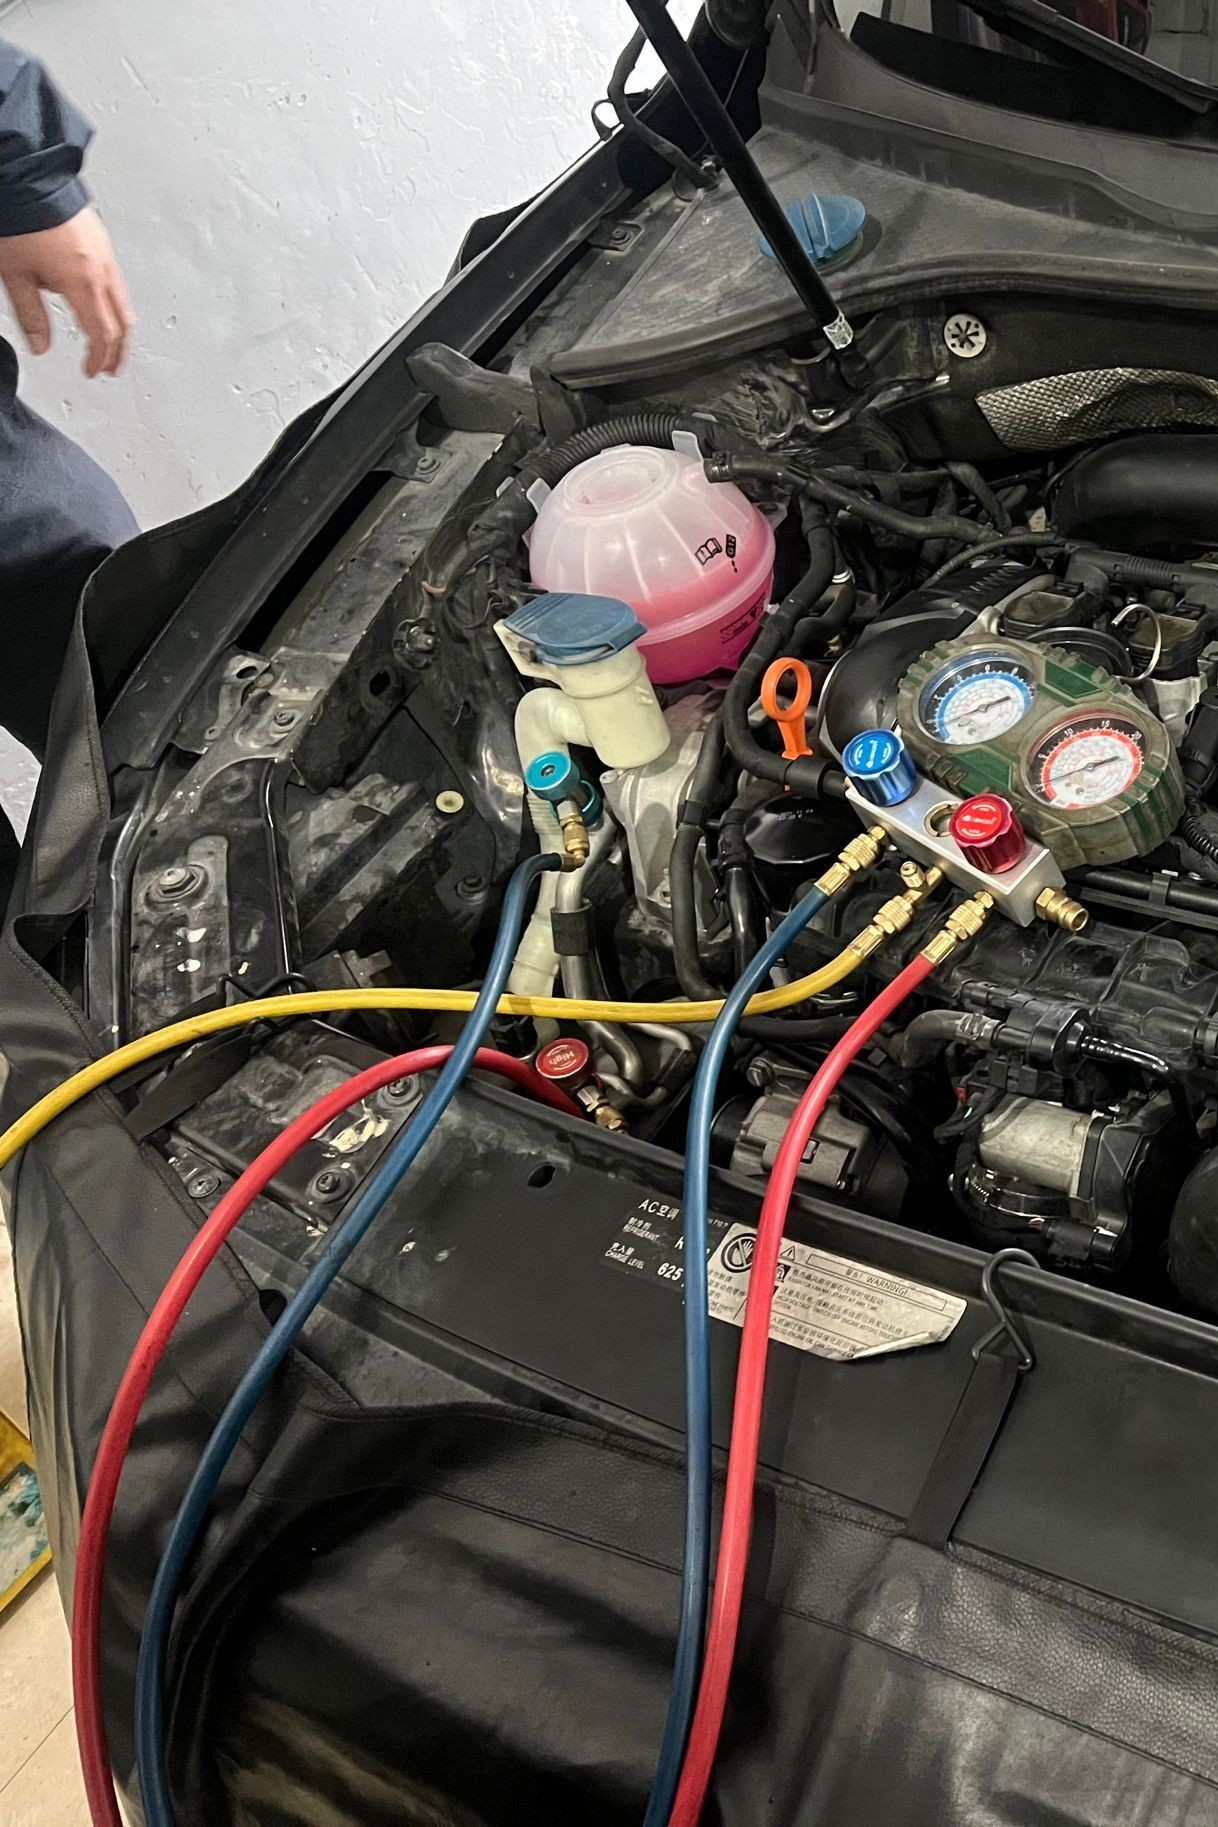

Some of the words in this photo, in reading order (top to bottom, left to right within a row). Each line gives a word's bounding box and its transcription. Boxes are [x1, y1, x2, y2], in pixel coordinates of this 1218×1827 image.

[1101, 720, 1110, 728] 15
[1064, 728, 1074, 736] 10
[549, 1051, 575, 1065] High
[605, 1249, 629, 1263] CHARGE
[628, 1258, 645, 1269] LEVEL
[866, 1276, 908, 1296] WARNING!
